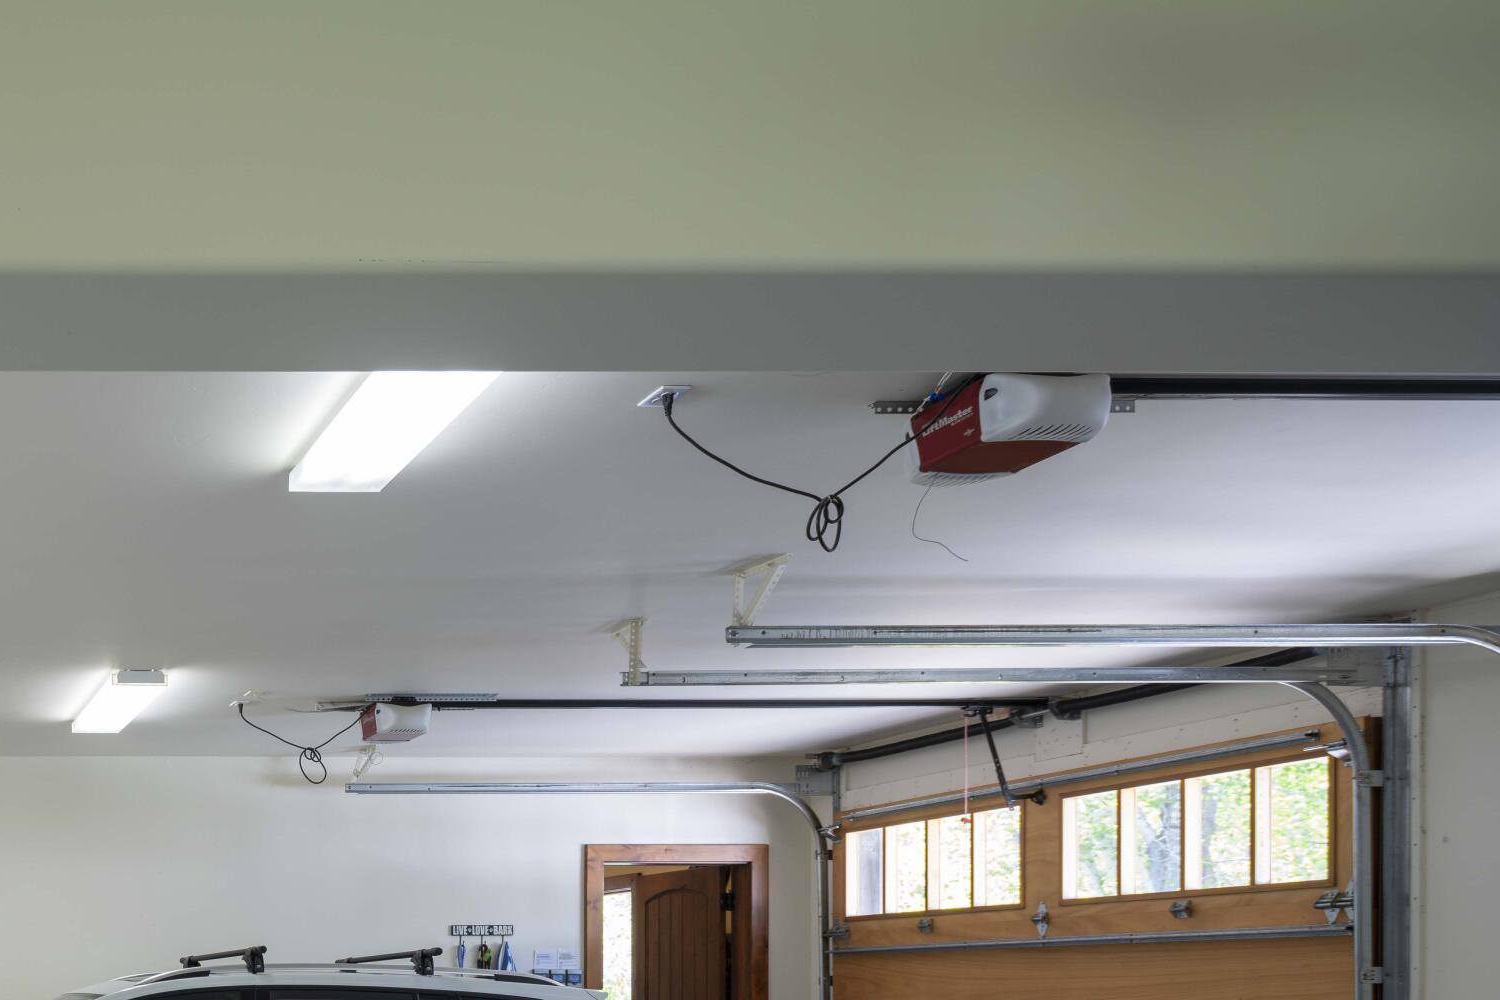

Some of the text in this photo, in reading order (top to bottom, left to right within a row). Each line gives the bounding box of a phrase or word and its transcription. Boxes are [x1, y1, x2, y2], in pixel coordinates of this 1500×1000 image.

[452, 925, 512, 936] LIVE LOVE BARK
